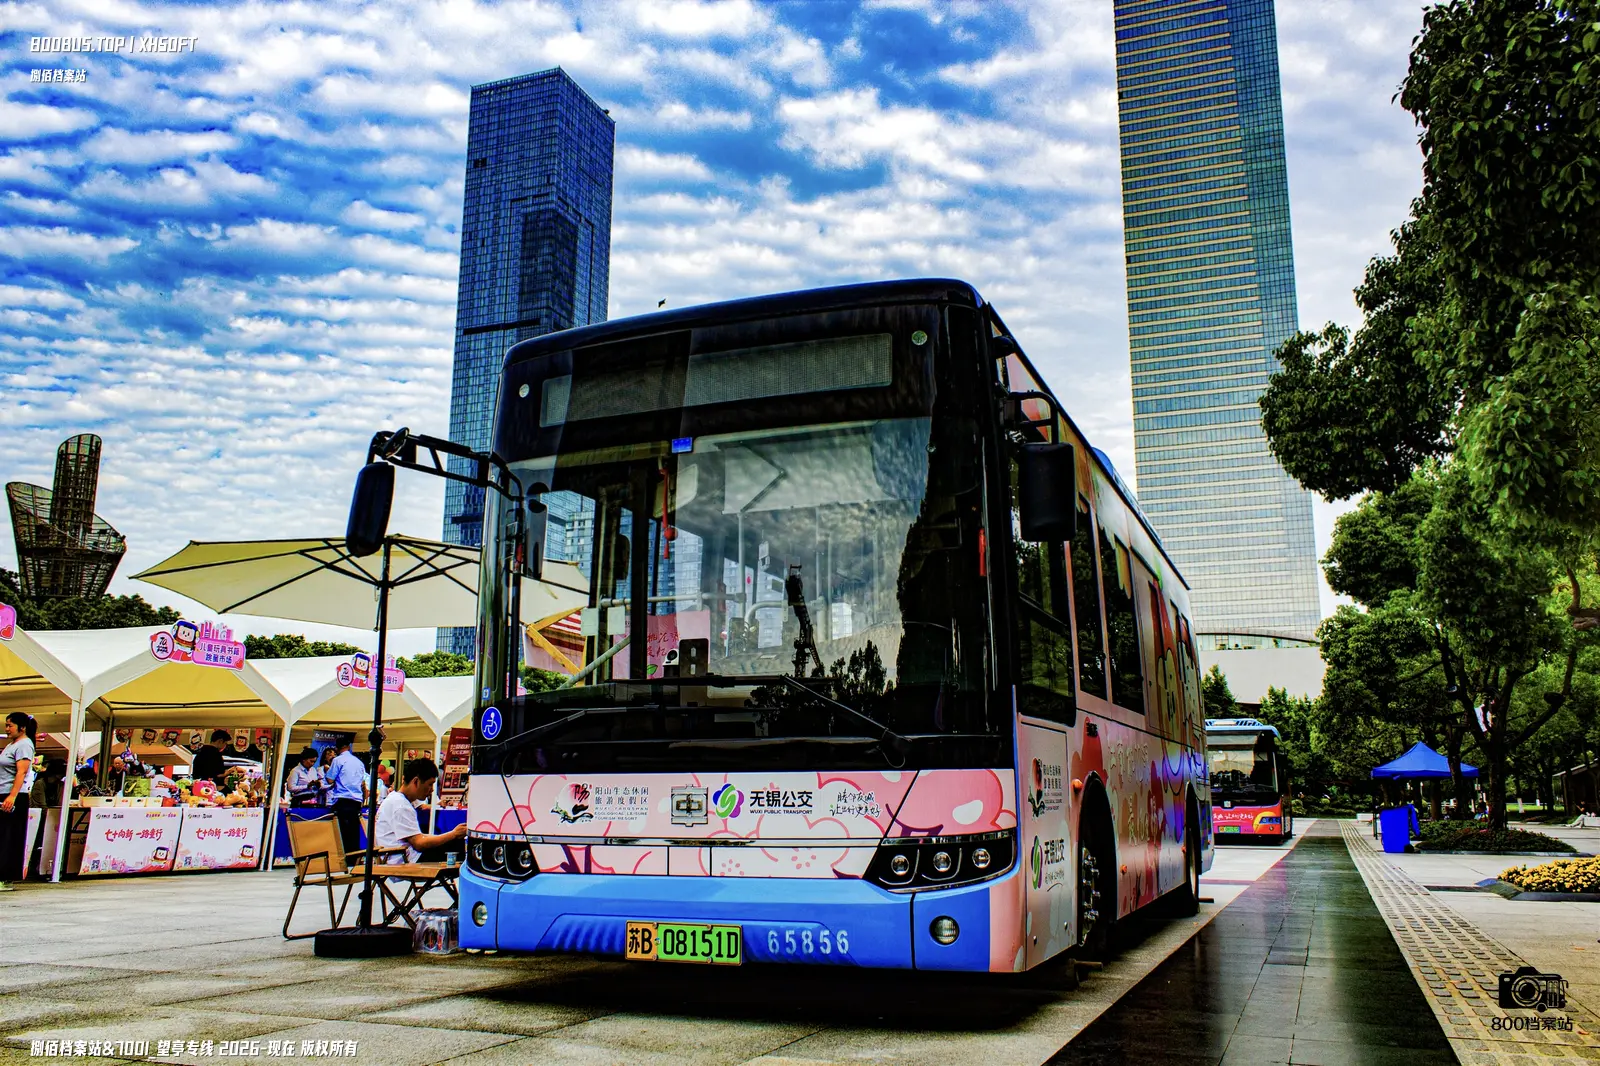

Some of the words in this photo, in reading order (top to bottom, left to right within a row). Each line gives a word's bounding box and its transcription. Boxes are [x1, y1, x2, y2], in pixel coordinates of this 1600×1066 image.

[200, 642, 240, 656] 儿童玩具书籍
[205, 653, 233, 664] 跳蚤市场
[595, 787, 649, 795] 阳山生态休闲
[595, 796, 648, 804] 旅游度假区
[749, 790, 813, 808] 无锡公交
[105, 828, 134, 842] 七十向新
[136, 828, 163, 842] 一路童行
[196, 827, 222, 840] 七十向新
[224, 827, 248, 840] 一路童行
[628, 927, 653, 955] 苏B
[663, 928, 739, 959] 08151D
[767, 929, 850, 955] 65856
